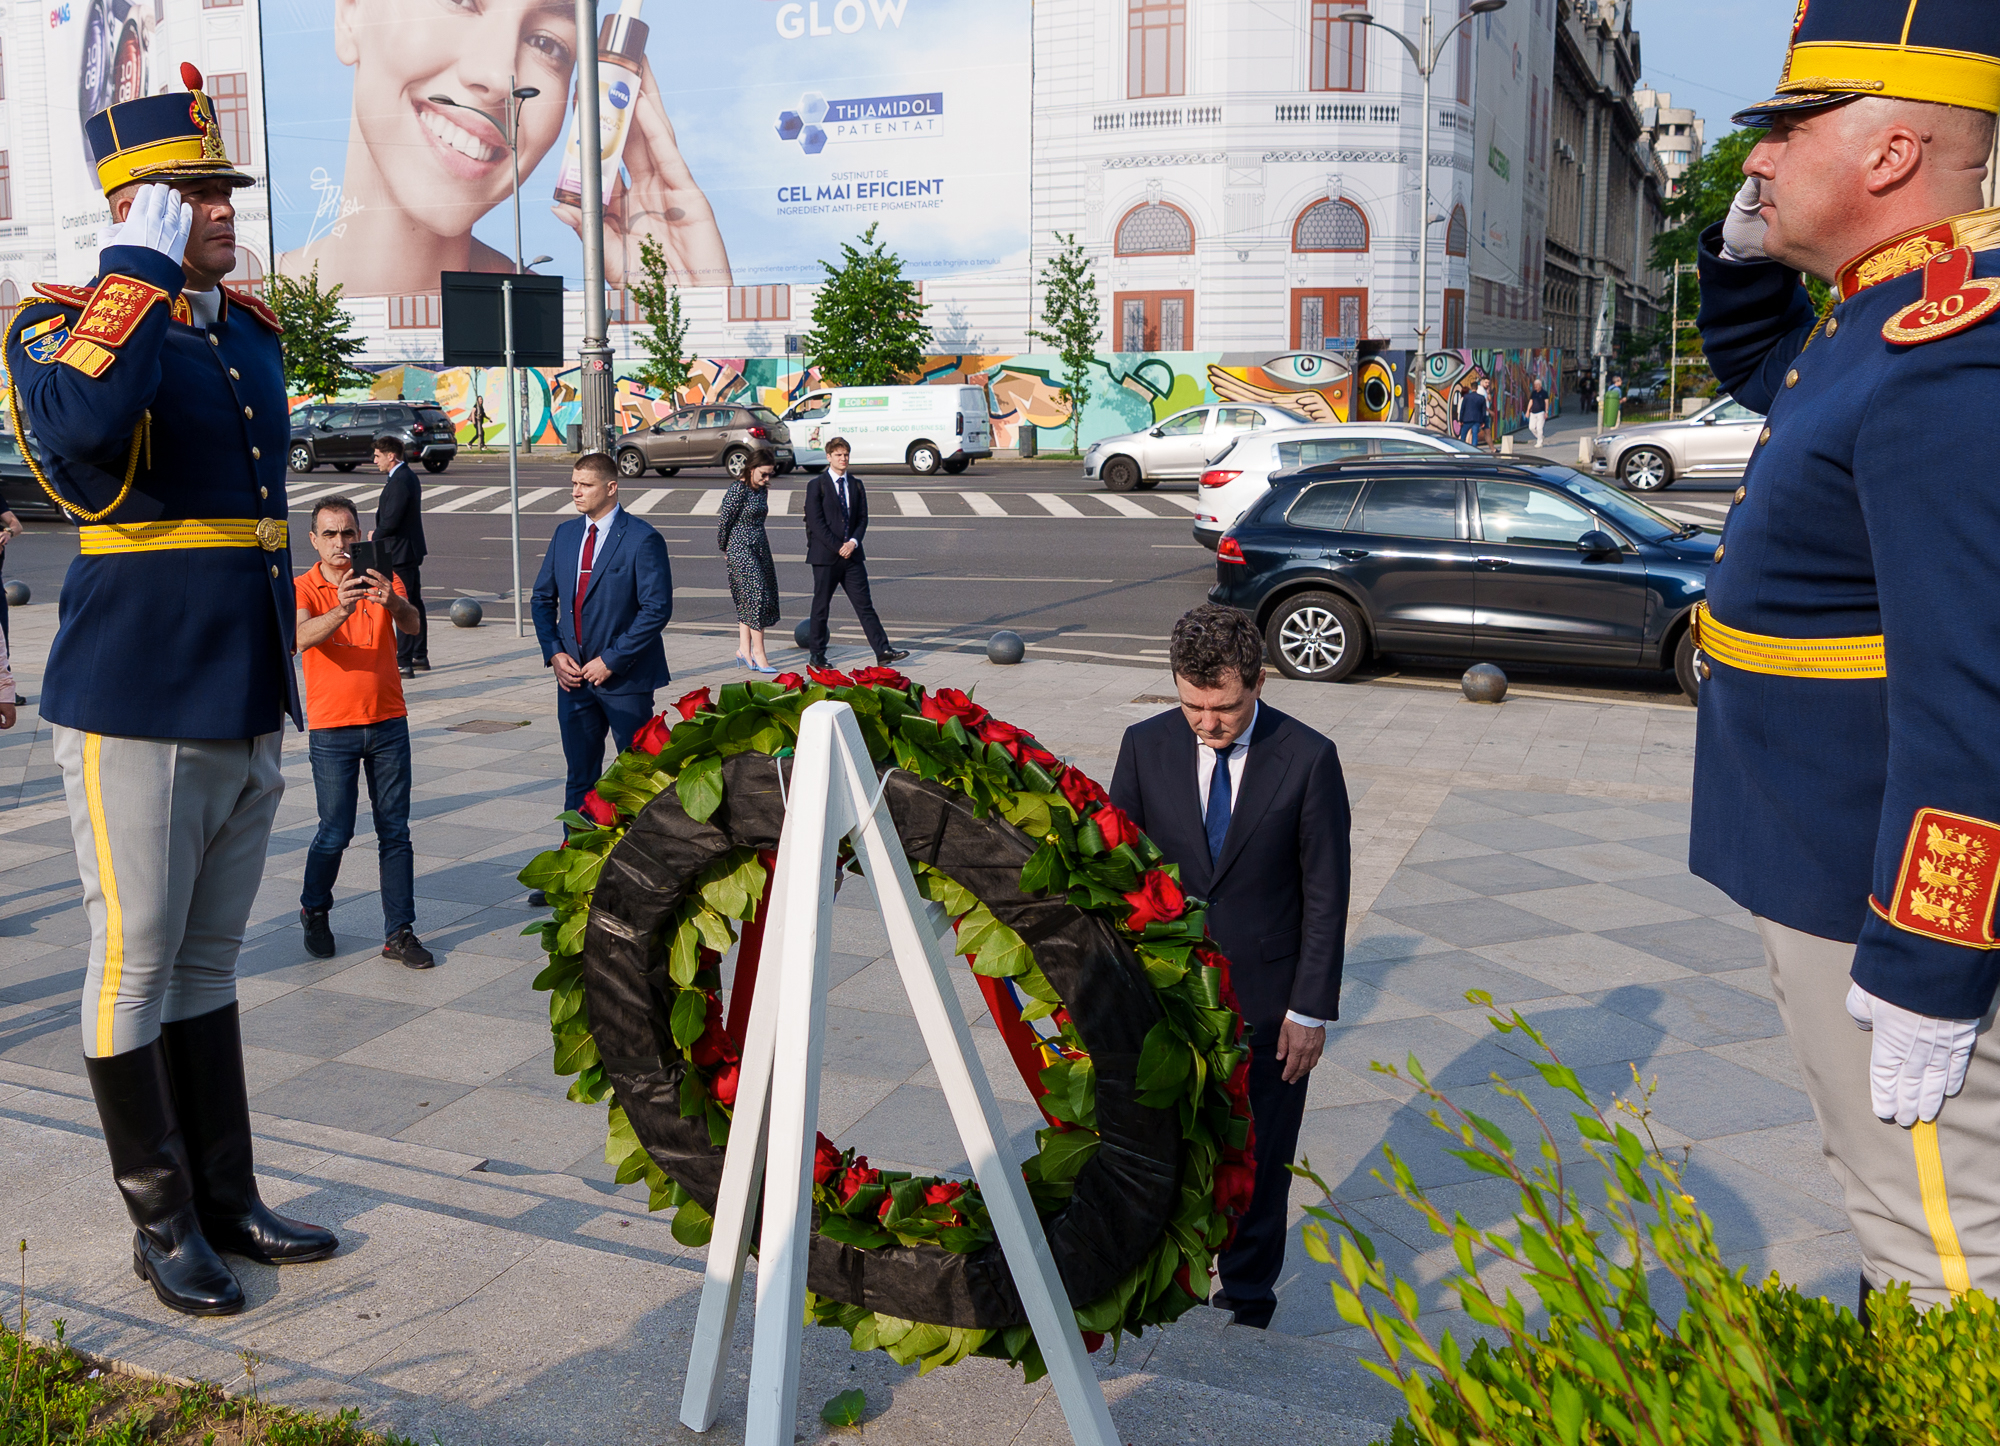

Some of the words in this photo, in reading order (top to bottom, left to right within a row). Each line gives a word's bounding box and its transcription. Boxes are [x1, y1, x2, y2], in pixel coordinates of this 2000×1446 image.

[50, 3, 71, 28] eMAG
[775, 0, 909, 40] GLOW
[87, 43, 97, 67] 10
[85, 66, 97, 90] 08
[120, 61, 132, 82] 10
[119, 82, 131, 102] 08
[610, 88, 629, 102] NIVEA
[836, 98, 935, 120] THIAMIDOL
[837, 119, 935, 136] PATENTAT
[831, 170, 875, 181] SUSȚINUT
[876, 170, 889, 179] DE
[777, 186, 812, 203] CEL
[817, 184, 851, 201] MAI
[857, 179, 944, 199] EFICIENT
[777, 204, 830, 215] INGREDIENT
[832, 202, 879, 213] ANTI-PETE
[74, 232, 98, 250] HUAWEI
[1918, 294, 1964, 325] 30
